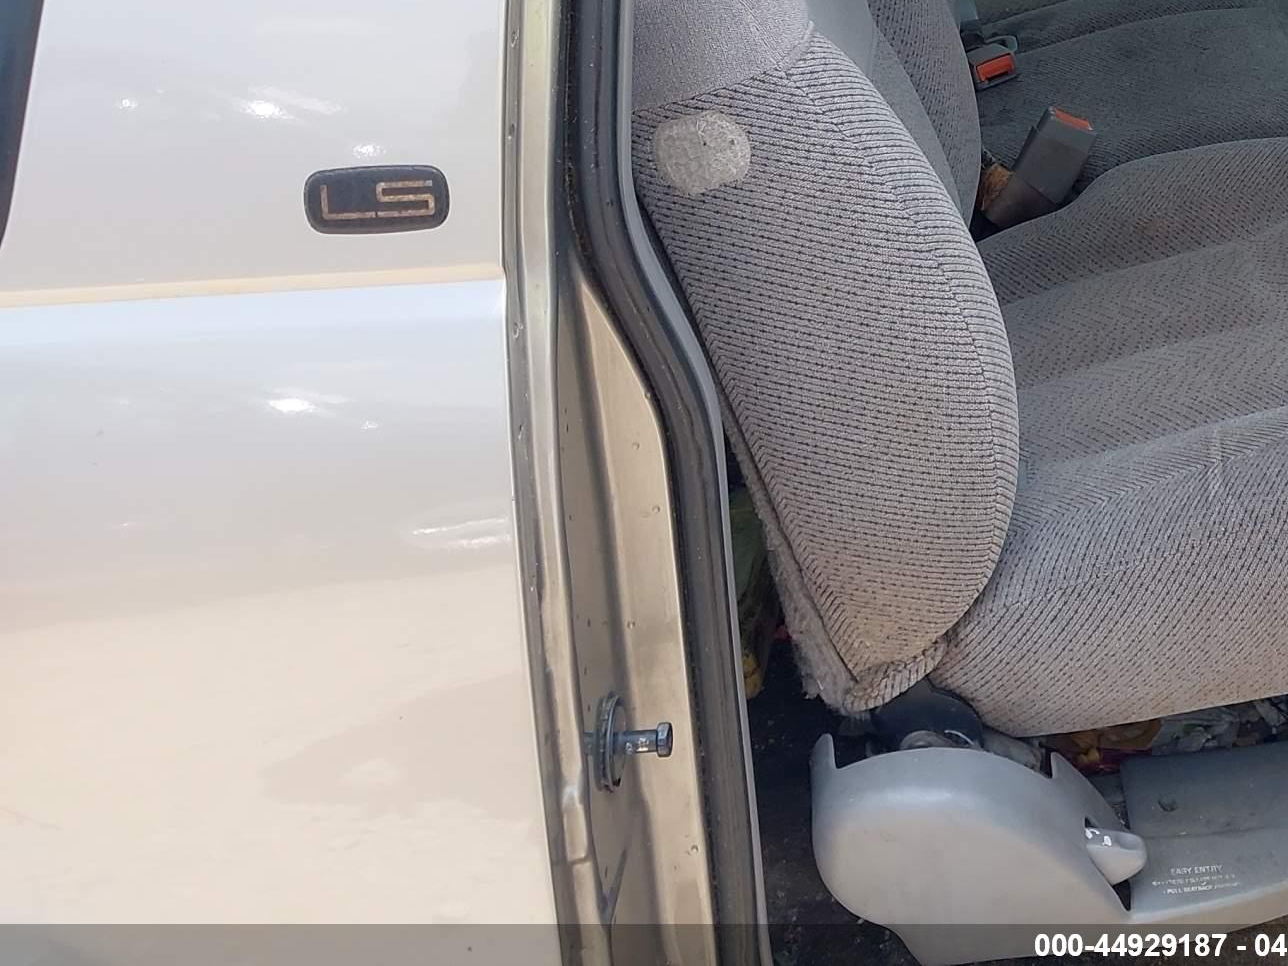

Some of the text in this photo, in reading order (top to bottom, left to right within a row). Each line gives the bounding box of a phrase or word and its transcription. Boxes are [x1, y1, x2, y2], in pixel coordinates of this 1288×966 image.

[320, 180, 435, 220] LS
[1170, 864, 1223, 875] EASY ENTRY
